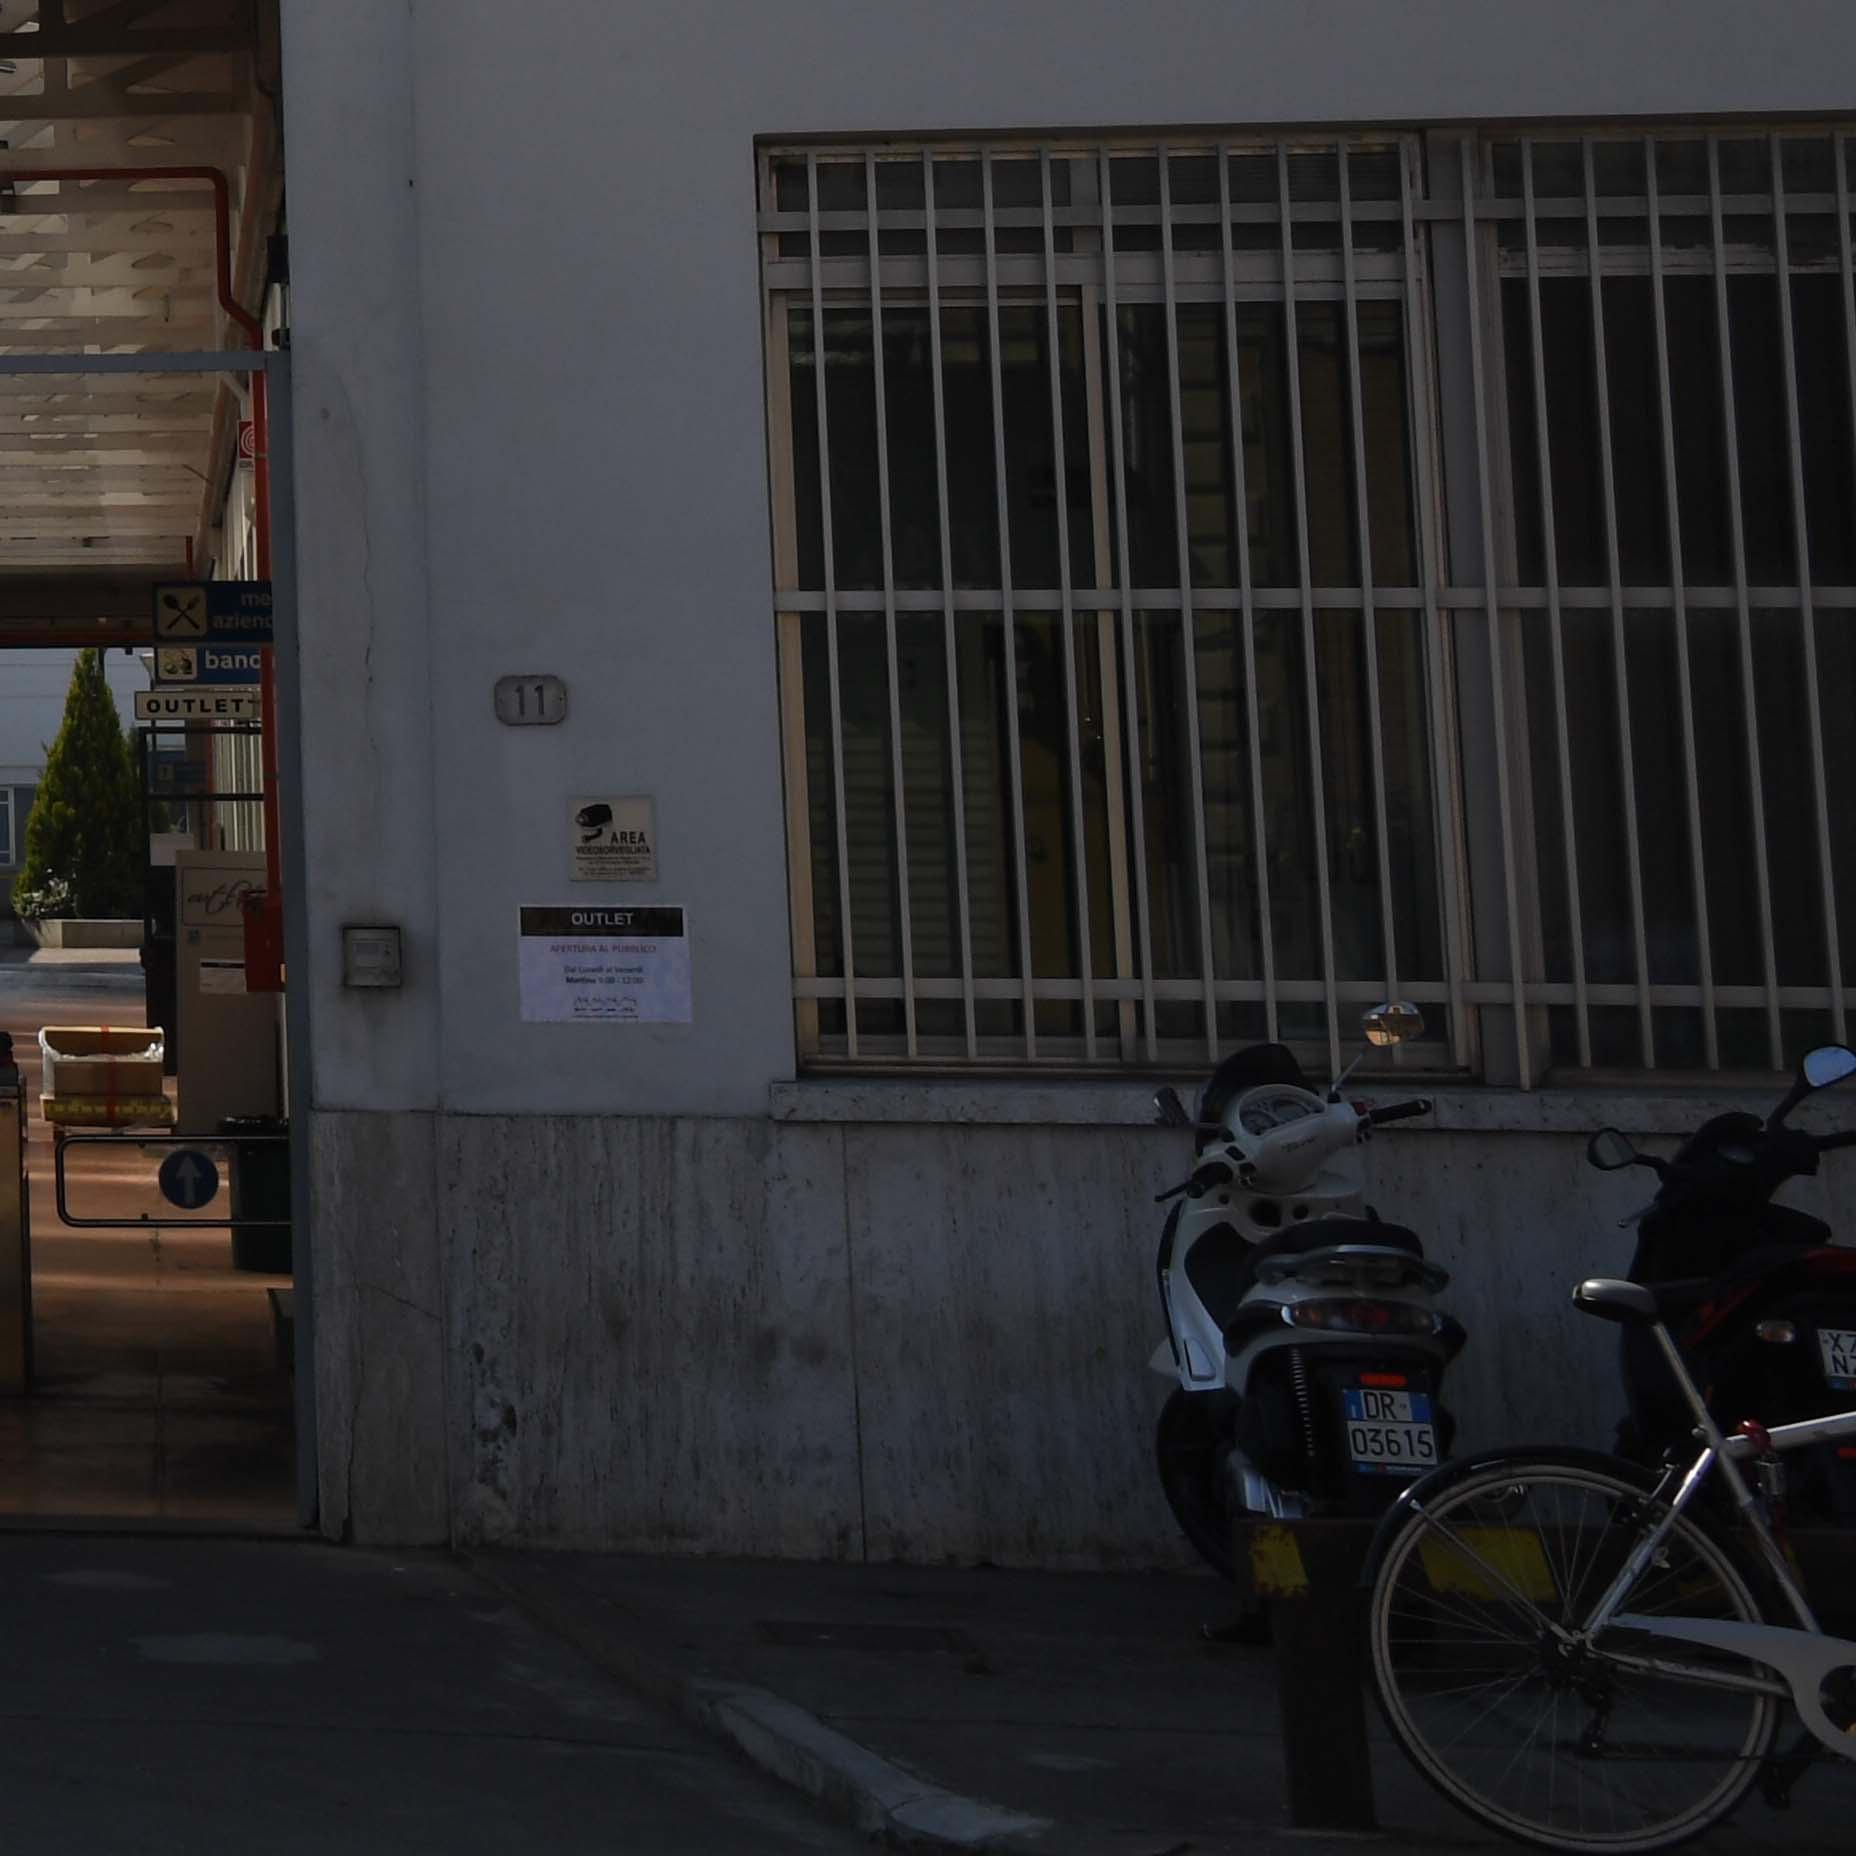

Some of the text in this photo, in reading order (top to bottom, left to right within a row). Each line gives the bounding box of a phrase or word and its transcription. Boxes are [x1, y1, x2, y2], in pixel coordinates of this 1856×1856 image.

[146, 698, 244, 714] OUTLET
[514, 684, 546, 716] 11
[610, 831, 646, 844] AREA
[571, 912, 634, 926] OUTLET
[1364, 1391, 1397, 1420] DR
[1351, 1428, 1434, 1458] 03615
